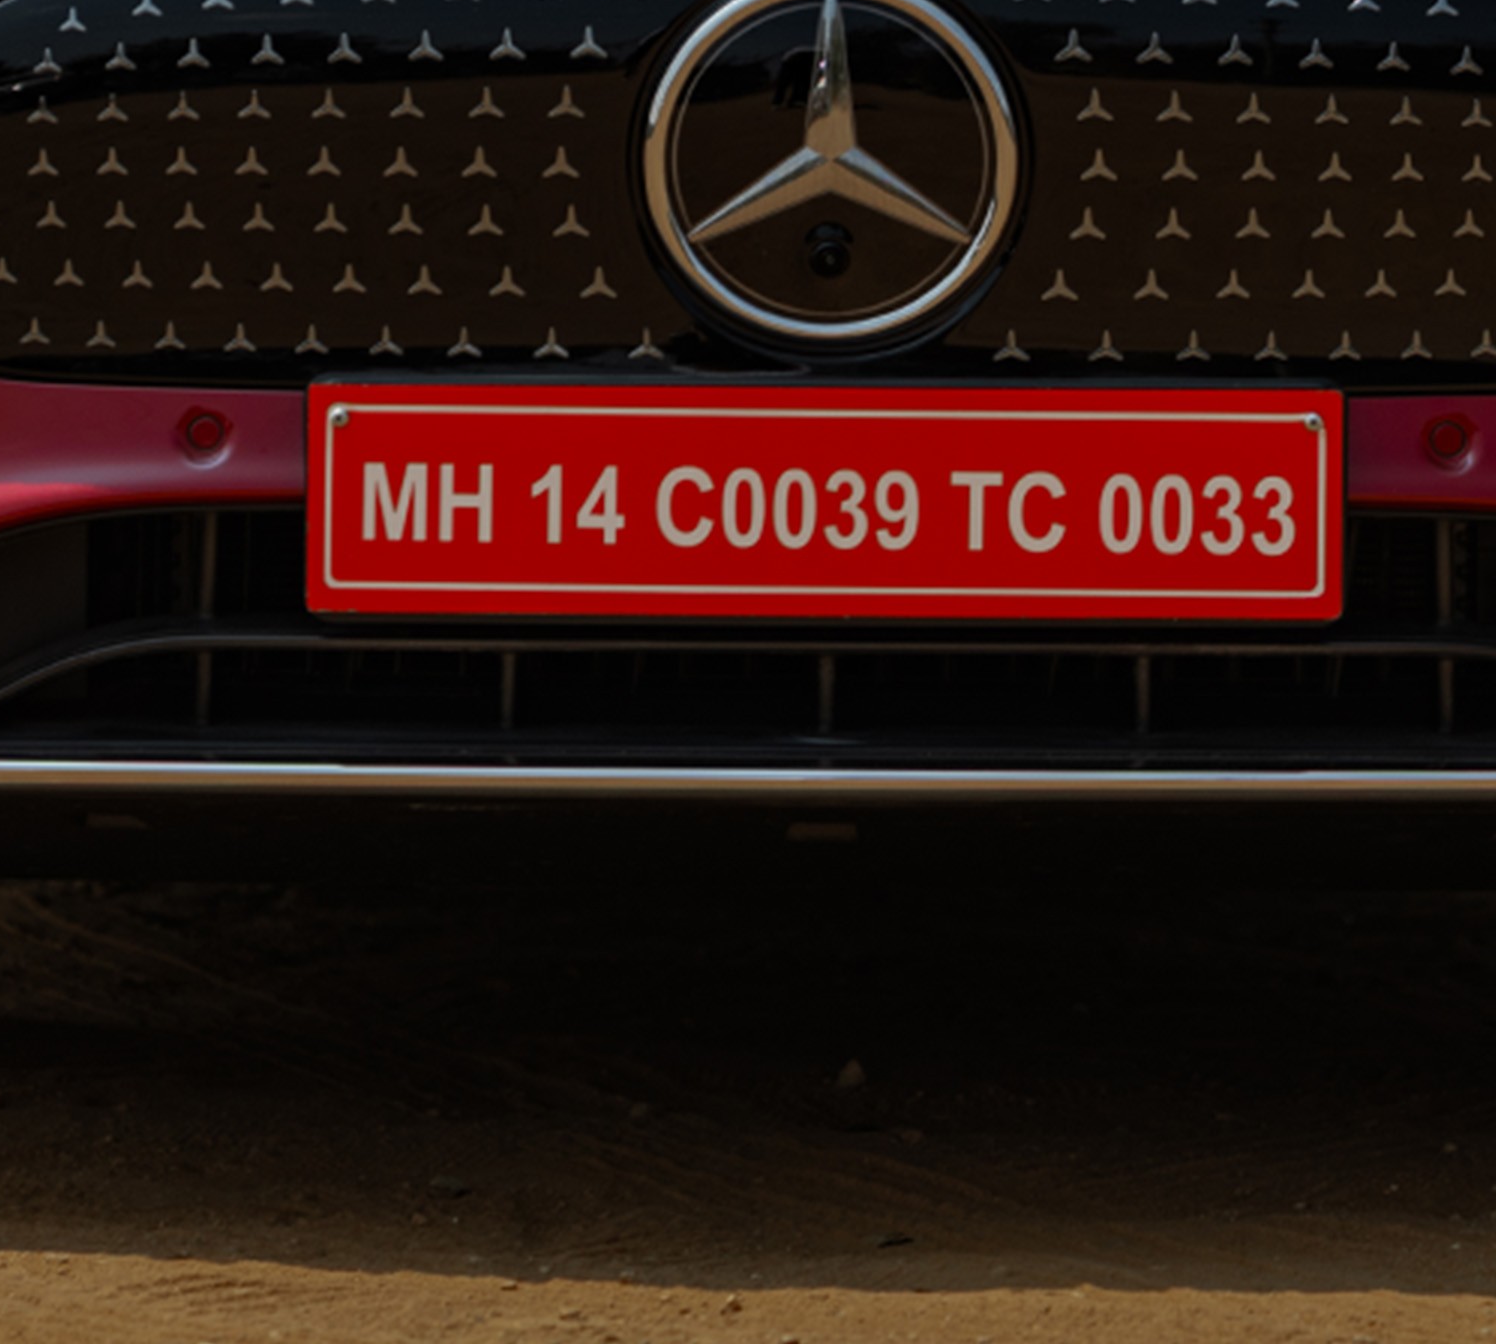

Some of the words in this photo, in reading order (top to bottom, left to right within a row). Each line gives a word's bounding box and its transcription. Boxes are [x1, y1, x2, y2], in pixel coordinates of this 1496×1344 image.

[361, 462, 495, 543] MH
[530, 464, 626, 545] 14
[655, 465, 921, 551] C0039
[949, 471, 1067, 553] TC
[1098, 473, 1297, 556] 0033
